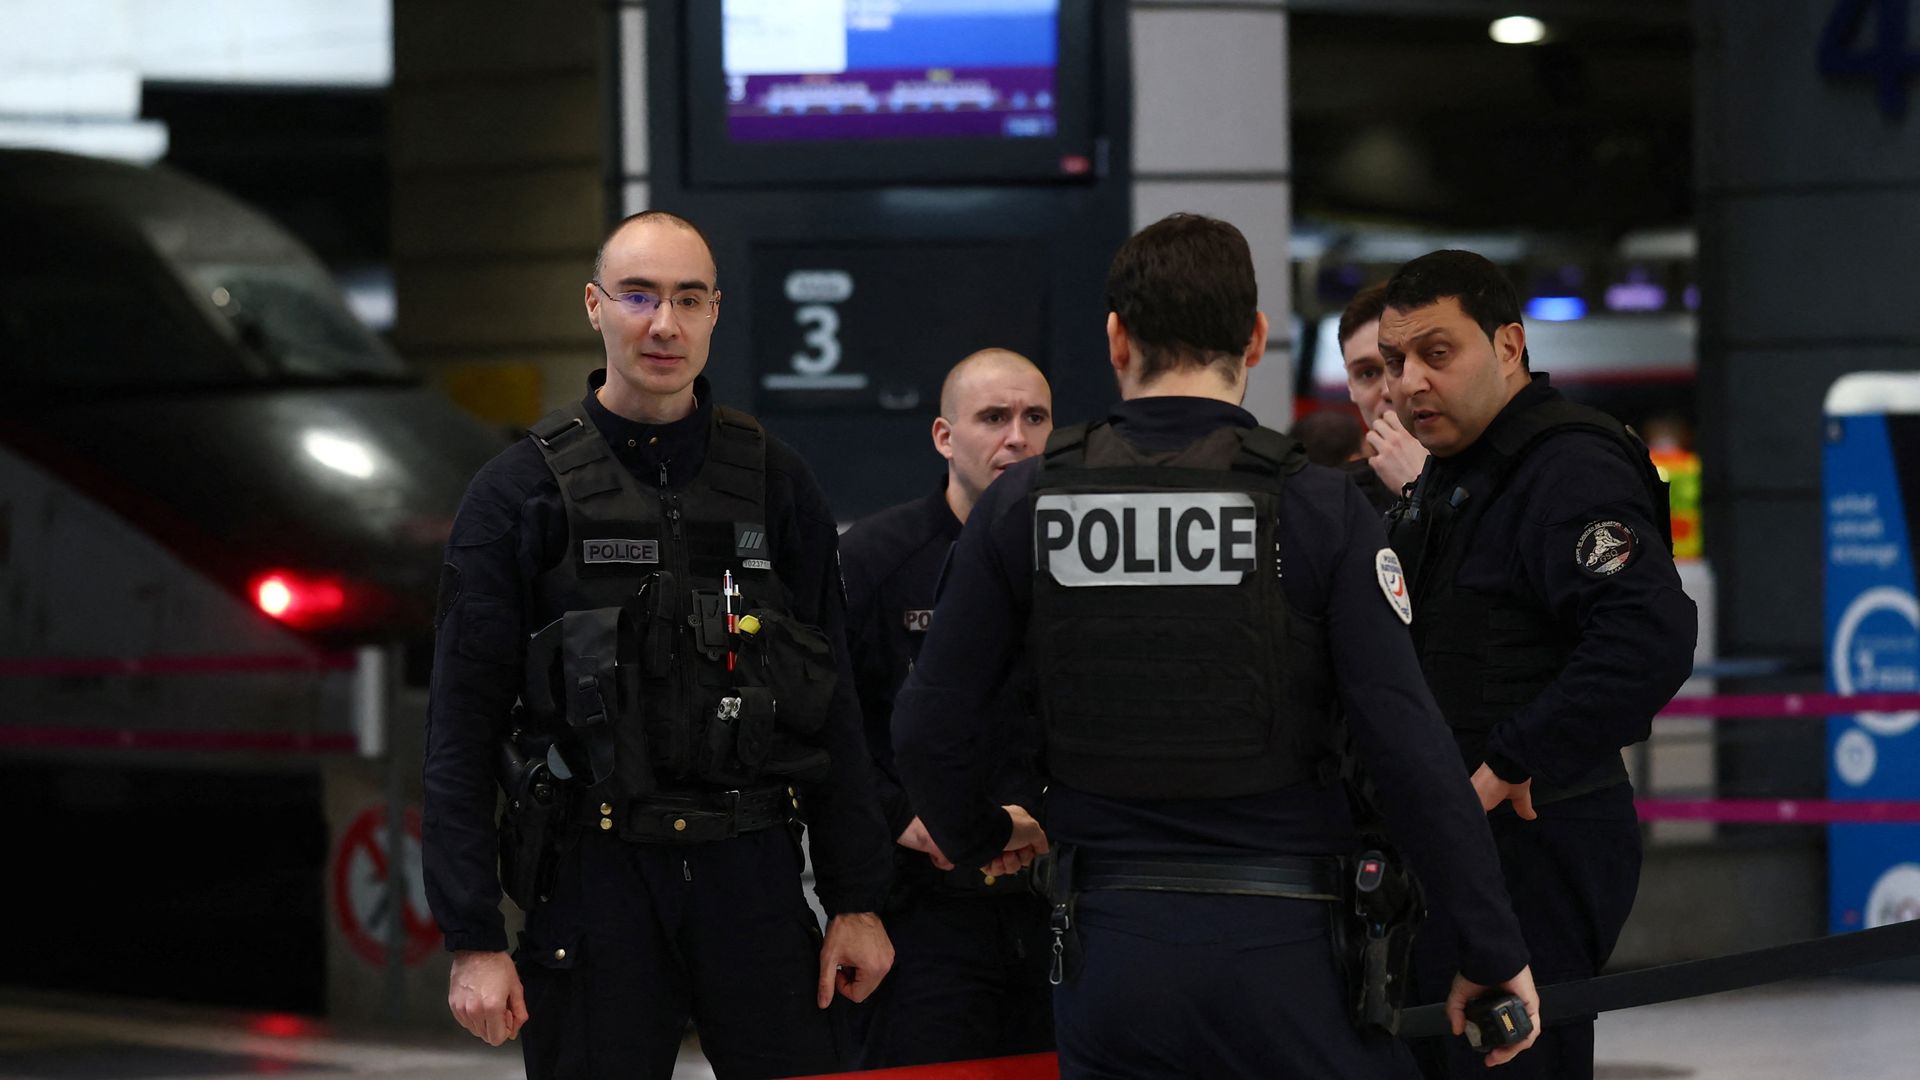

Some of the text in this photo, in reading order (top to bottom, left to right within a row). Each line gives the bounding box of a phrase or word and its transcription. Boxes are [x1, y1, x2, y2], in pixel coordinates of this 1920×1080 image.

[790, 304, 842, 375] 3
[589, 544, 654, 559] POLICE
[1037, 506, 1256, 574] POLICE
[905, 611, 932, 629] PO
